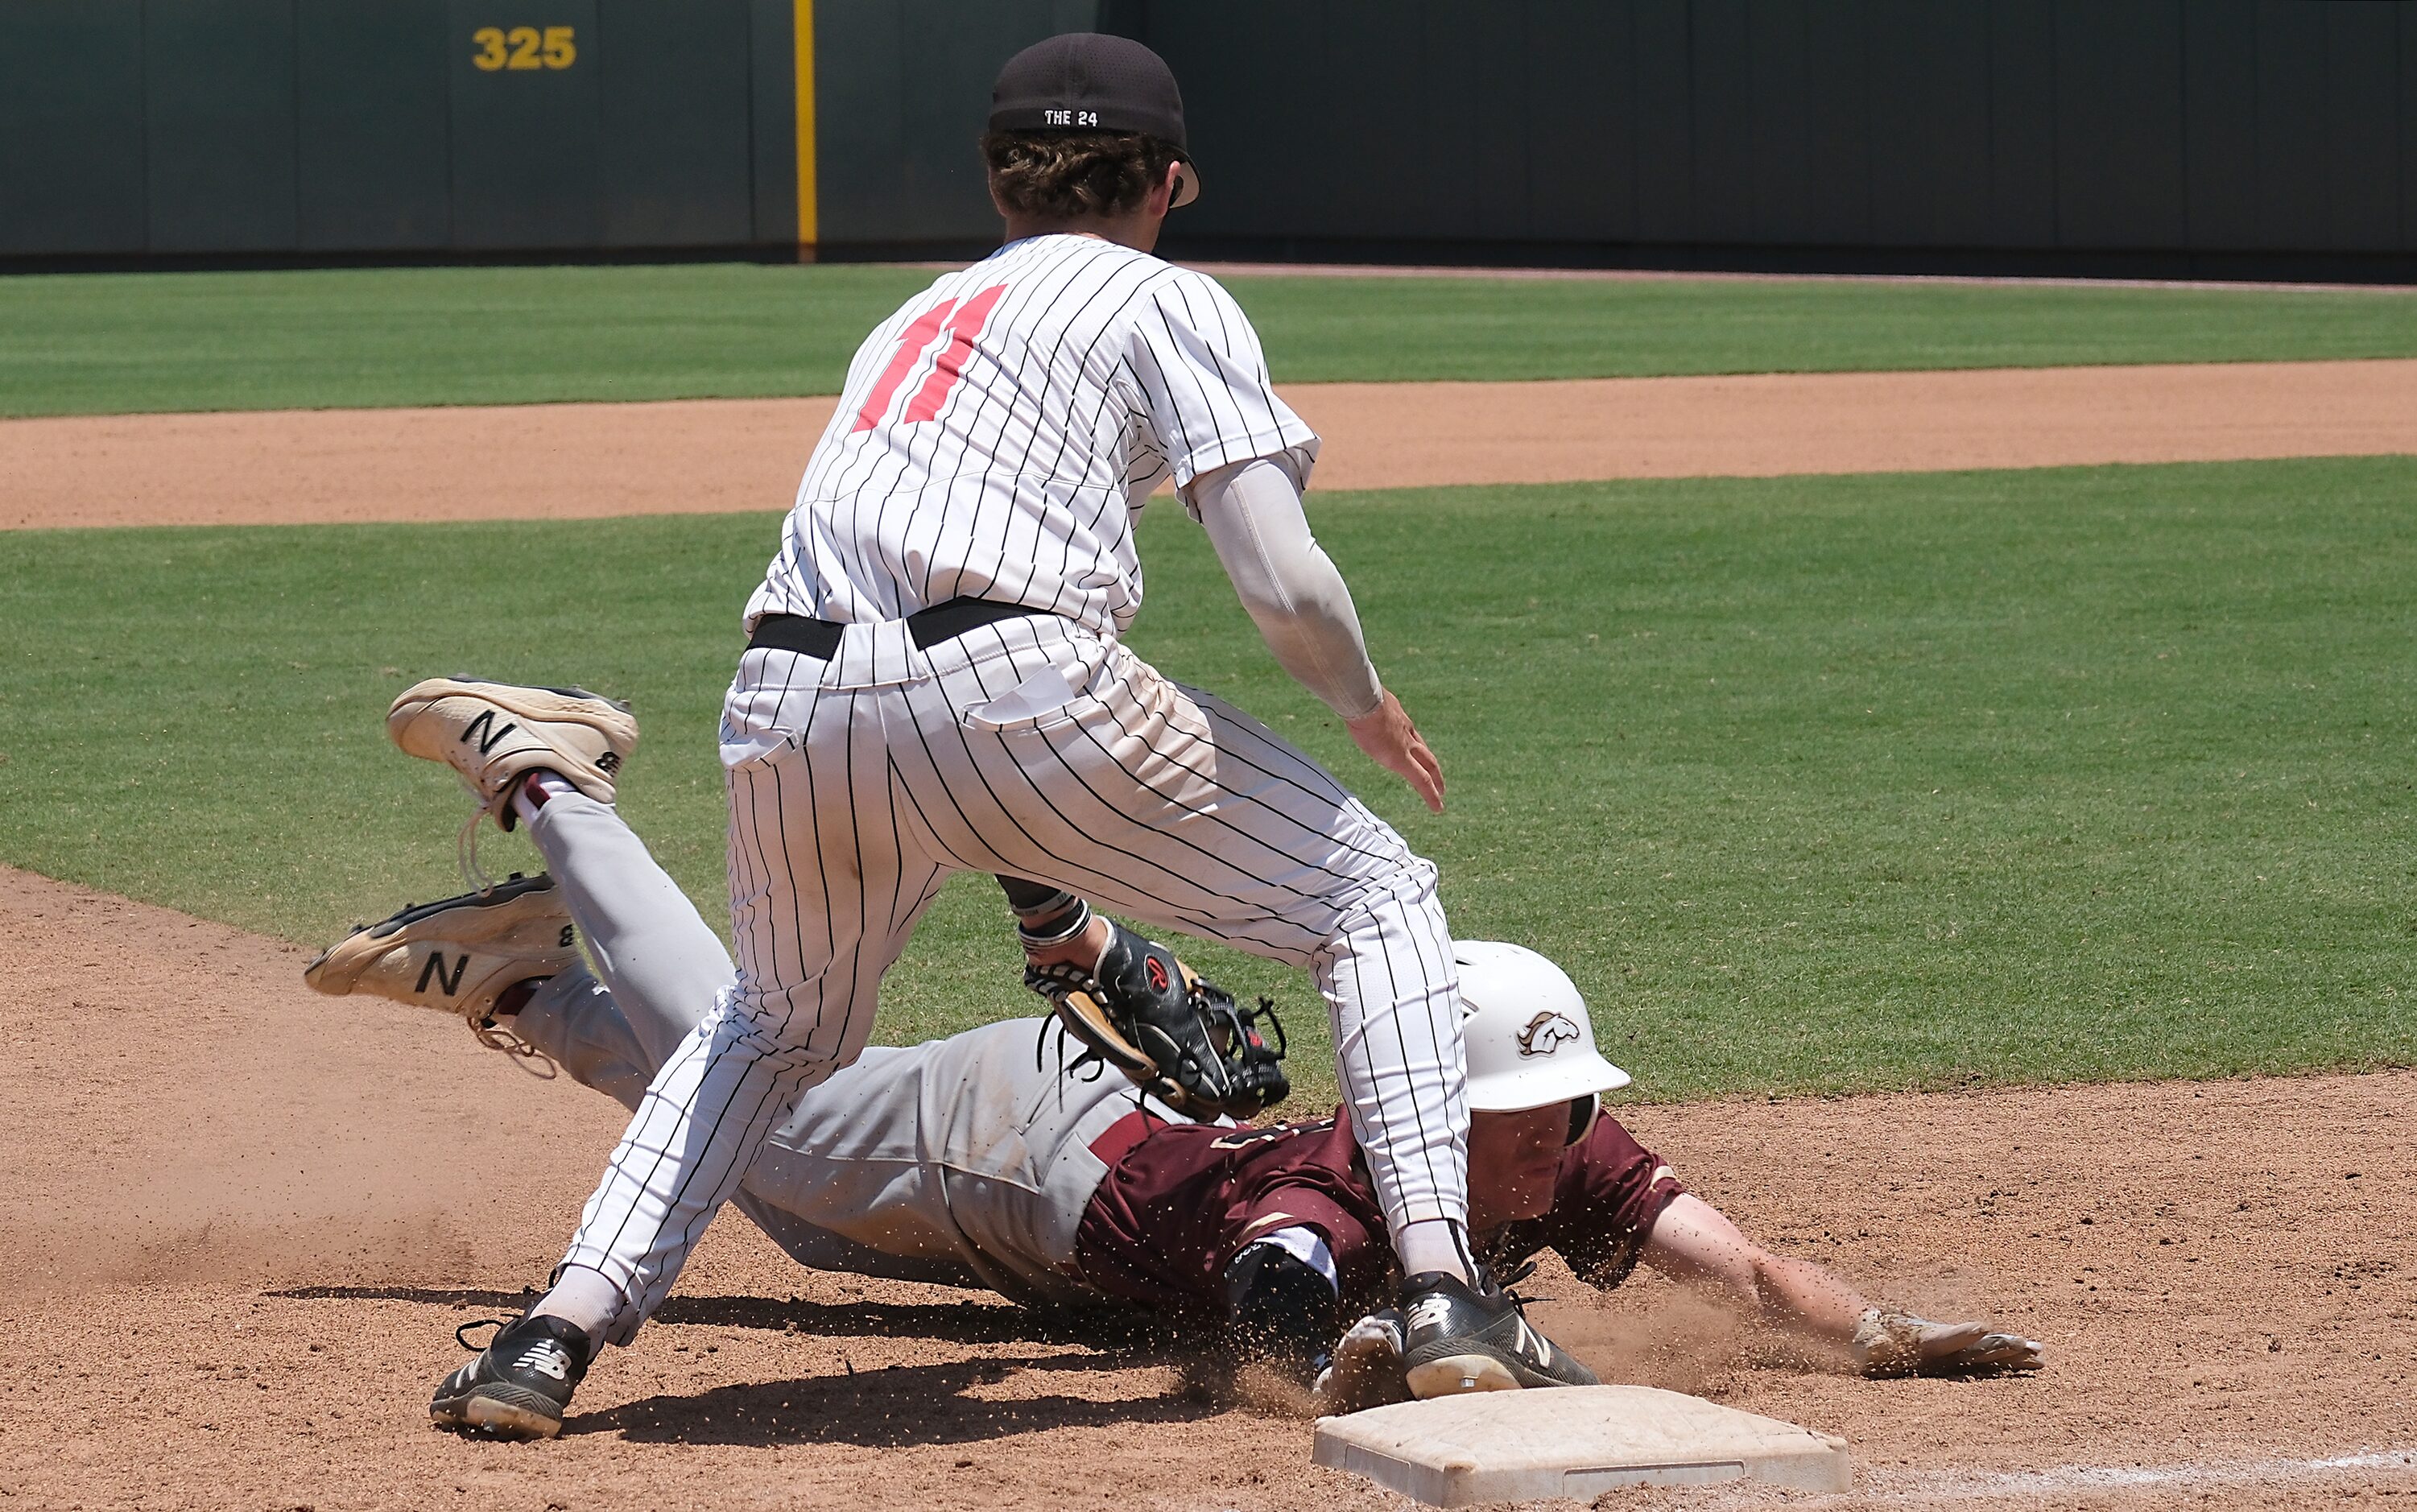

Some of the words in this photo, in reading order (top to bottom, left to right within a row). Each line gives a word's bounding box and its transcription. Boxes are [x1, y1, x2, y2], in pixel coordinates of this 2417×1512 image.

[472, 26, 577, 72] 325
[1044, 109, 1072, 126] THE
[1078, 110, 1098, 127] 24
[851, 283, 1009, 433] 11
[415, 950, 470, 997] N
